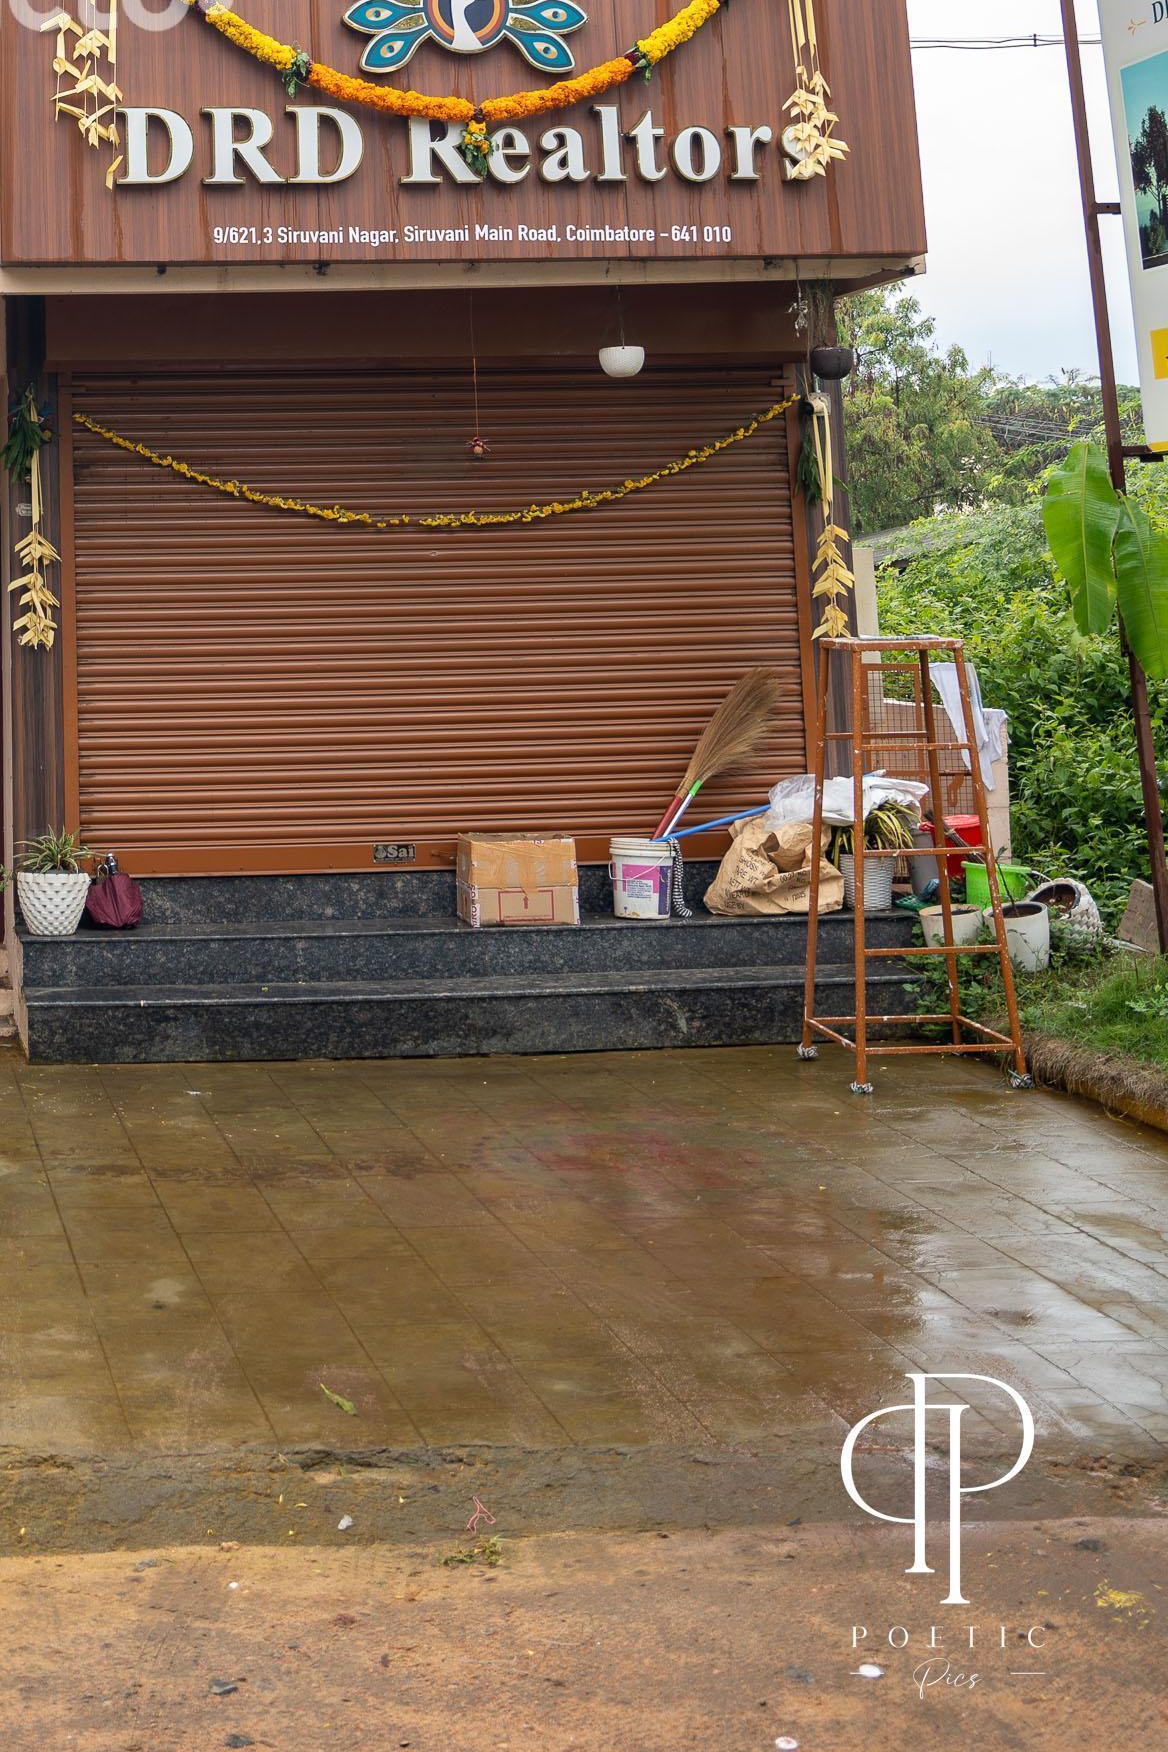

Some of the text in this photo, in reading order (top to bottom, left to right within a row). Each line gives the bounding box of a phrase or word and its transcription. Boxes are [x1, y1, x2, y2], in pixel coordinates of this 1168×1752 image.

[116, 103, 818, 185] DRD Realtors
[277, 226, 344, 244] Siruvani
[348, 226, 399, 247] Nagar,
[403, 225, 470, 243] Siruvani
[475, 225, 513, 242] Main
[518, 224, 562, 243] Road,
[566, 224, 655, 242] Coimbatore
[703, 225, 732, 243] 010
